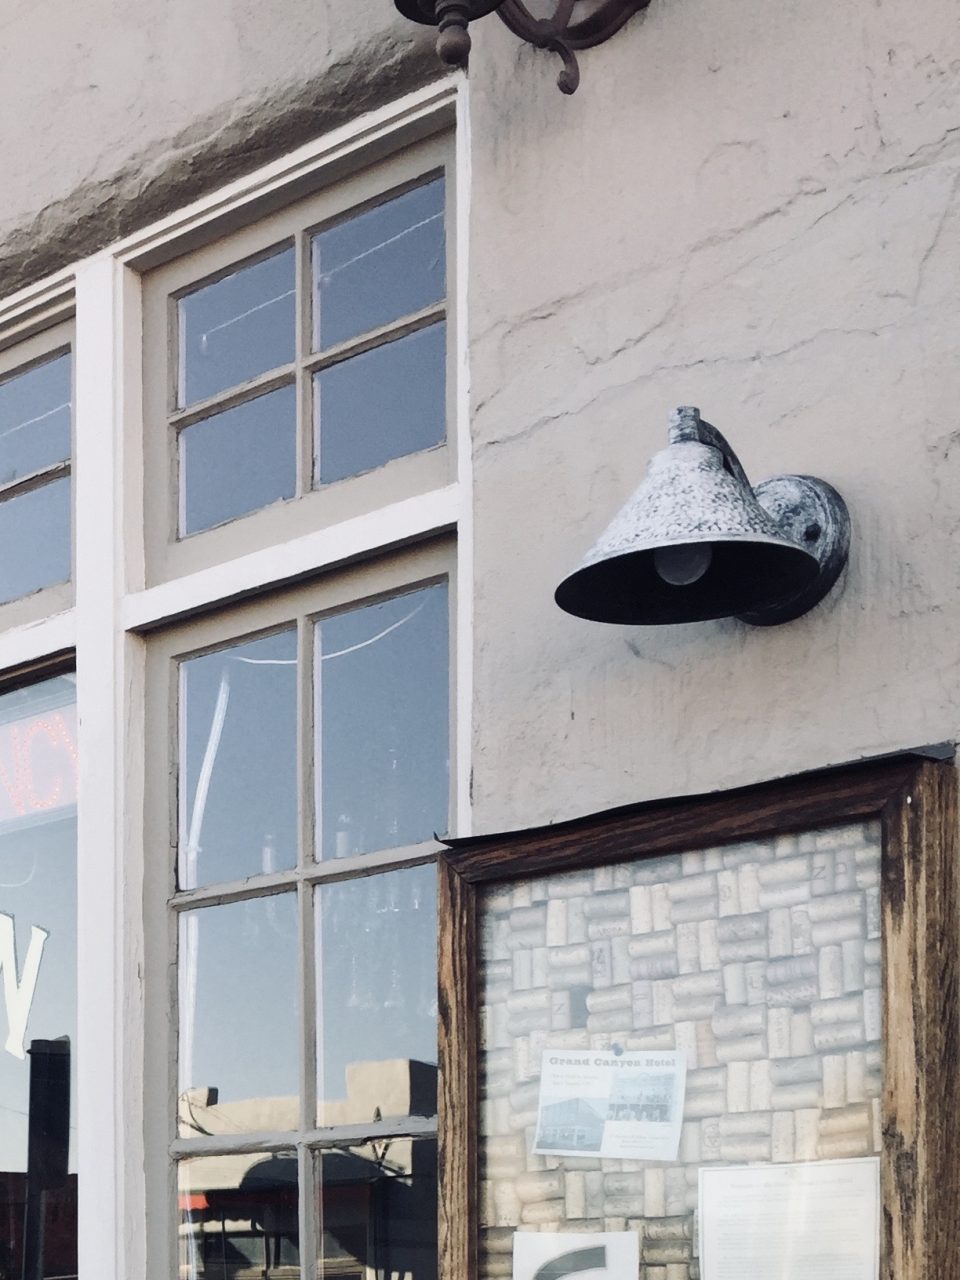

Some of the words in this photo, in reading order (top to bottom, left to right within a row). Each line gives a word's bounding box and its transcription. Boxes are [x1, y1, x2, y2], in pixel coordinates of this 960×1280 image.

[549, 1057, 590, 1066] Grand
[594, 1058, 641, 1068] Canyon
[645, 1058, 676, 1067] Hotel
